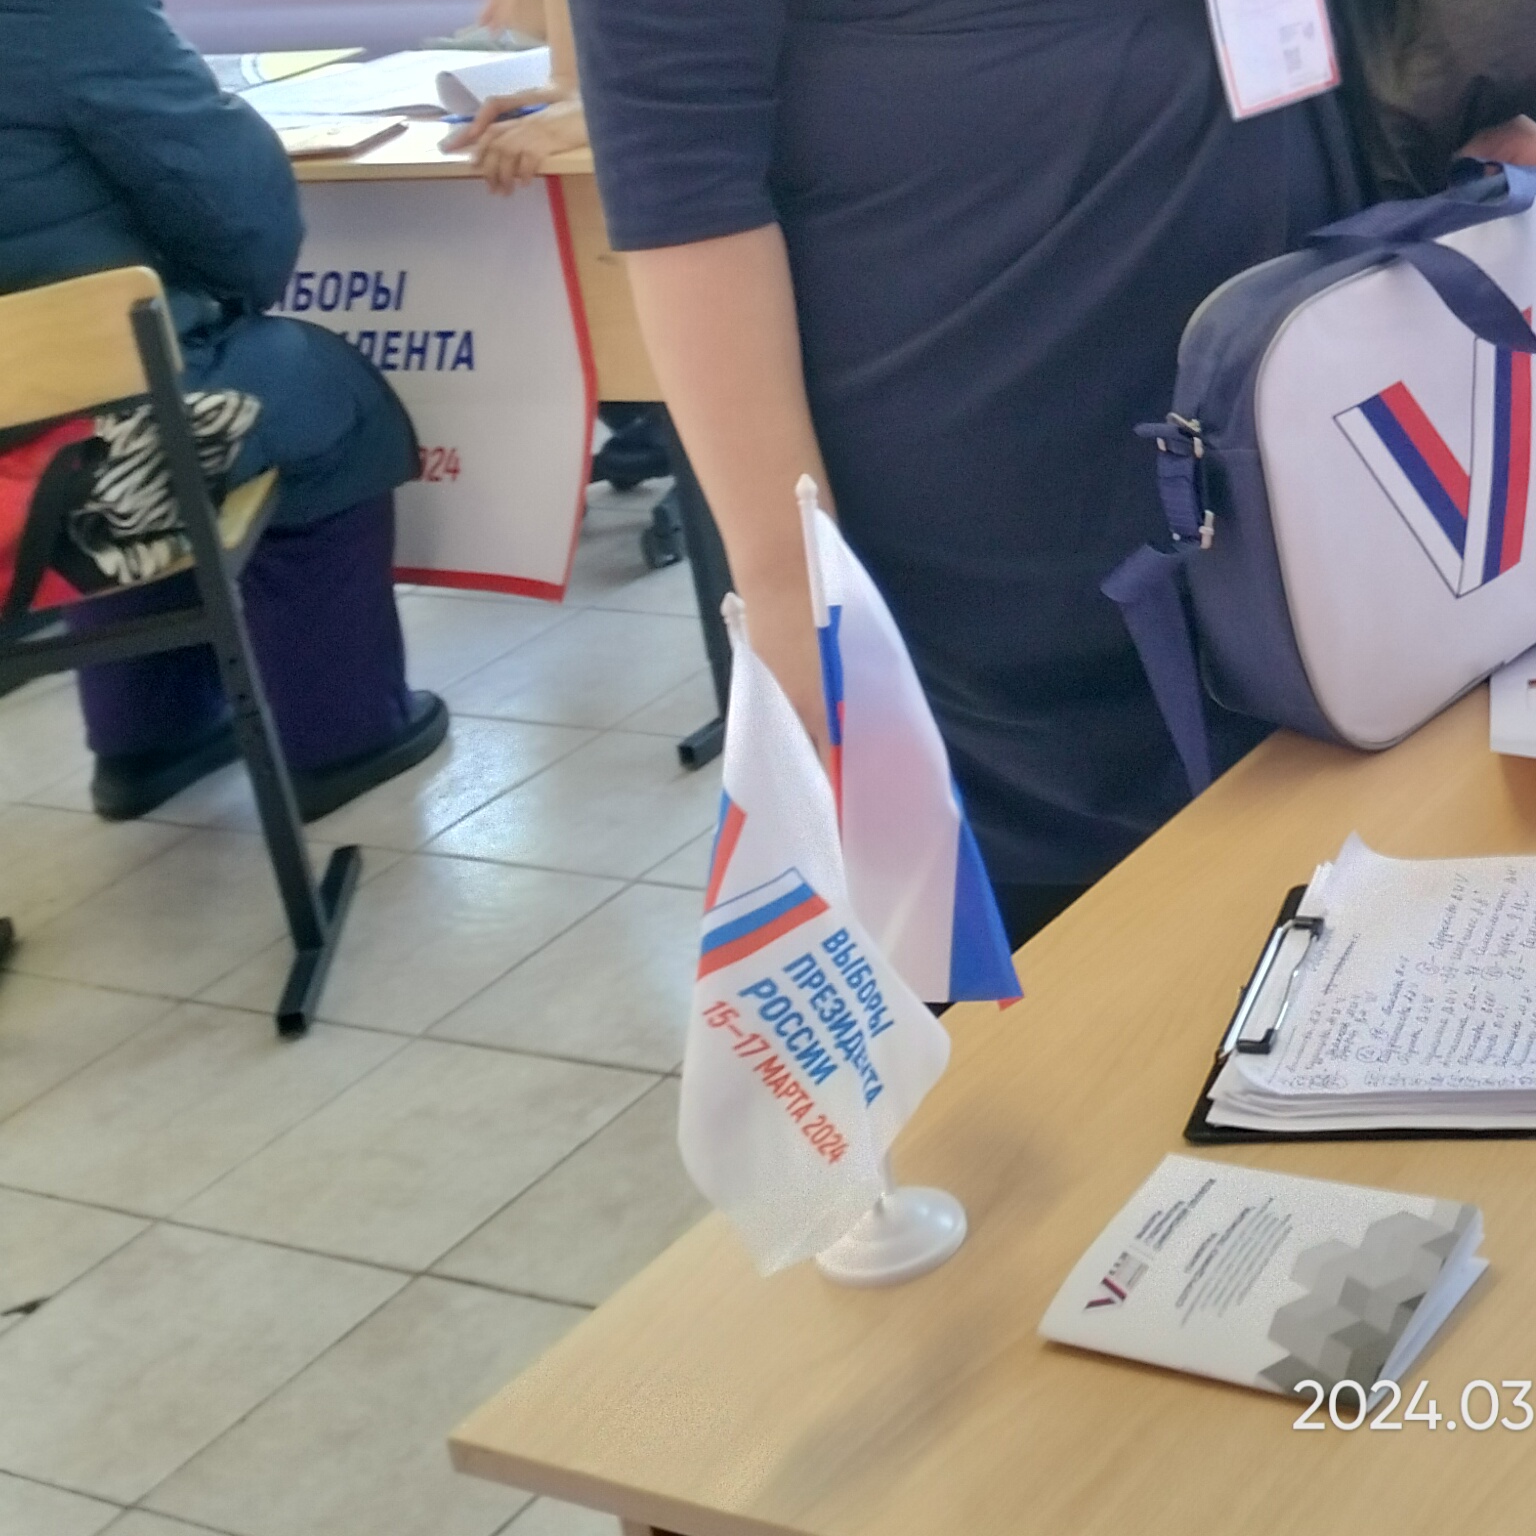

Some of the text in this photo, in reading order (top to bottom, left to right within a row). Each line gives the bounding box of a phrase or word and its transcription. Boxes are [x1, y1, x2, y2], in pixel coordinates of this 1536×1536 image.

[281, 270, 407, 312] БОРЫ
[345, 330, 475, 372] ДЕНТА
[738, 977, 838, 1086] РОССИИ
[820, 927, 894, 1038] ВЫБОРЫ
[753, 1054, 815, 1124] МАРТА
[801, 1114, 849, 1164] 2024
